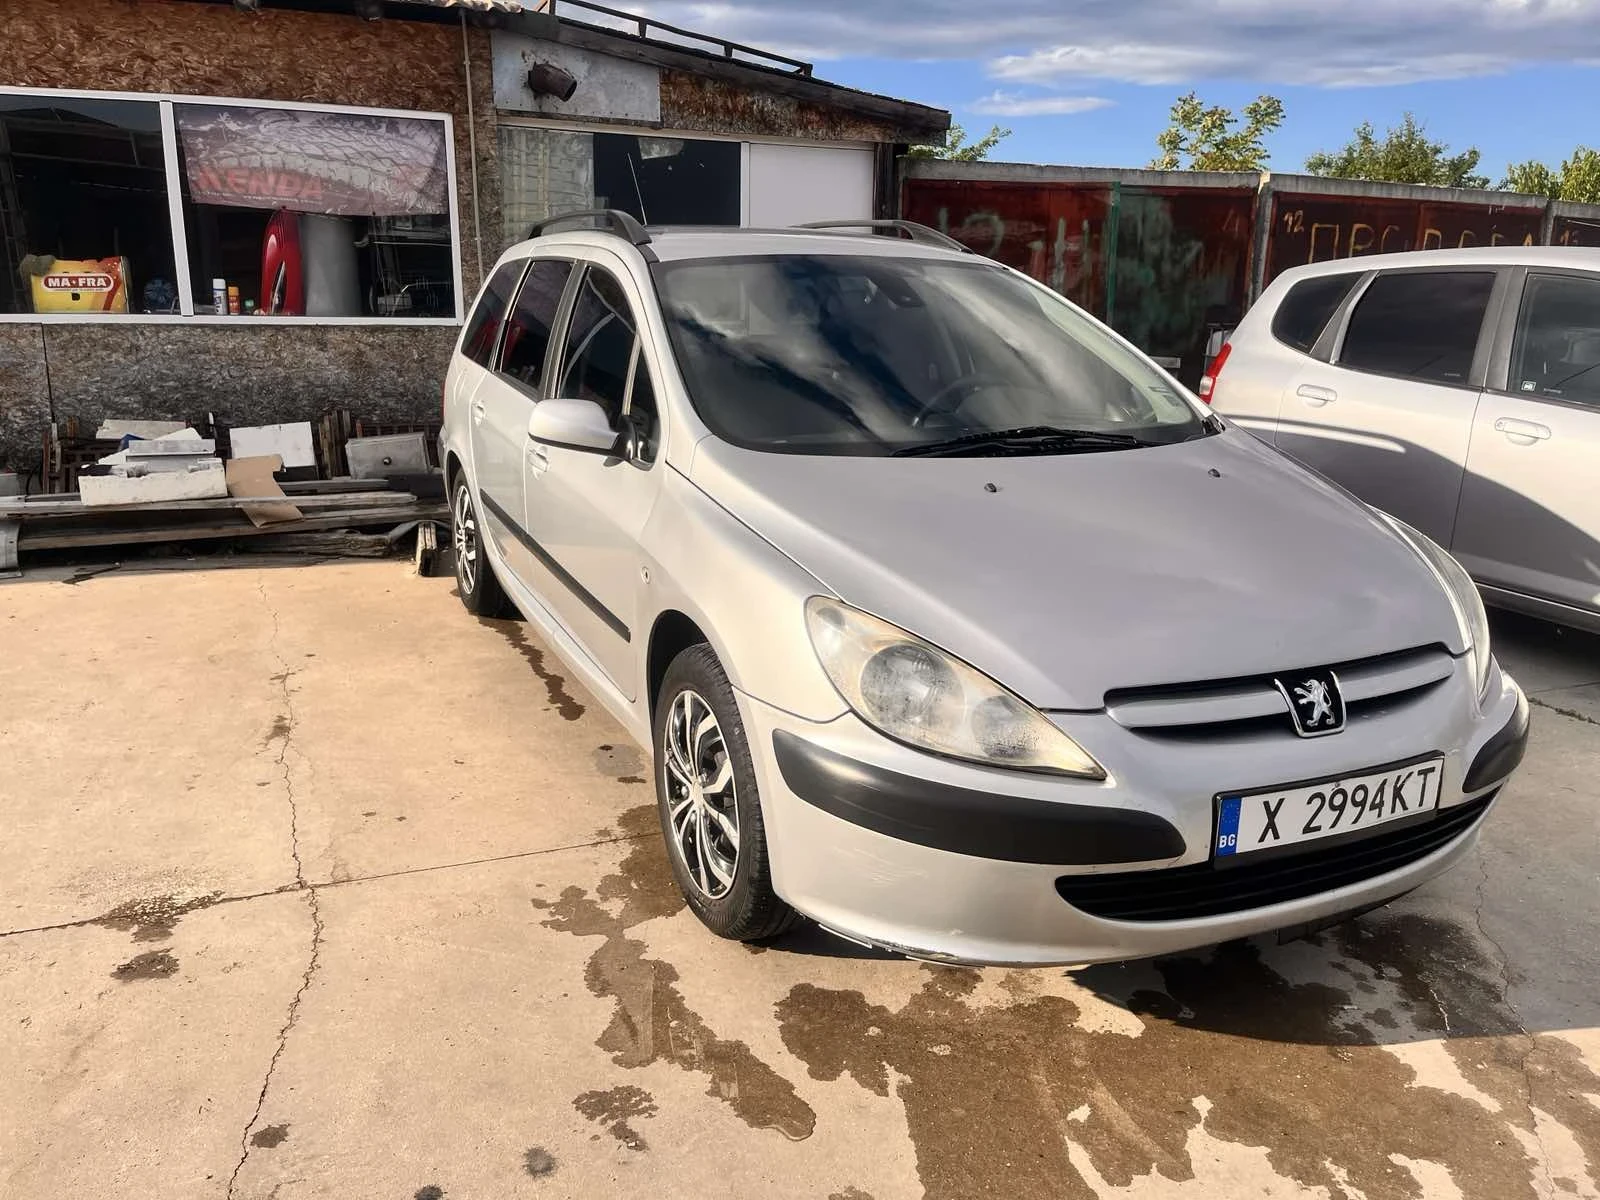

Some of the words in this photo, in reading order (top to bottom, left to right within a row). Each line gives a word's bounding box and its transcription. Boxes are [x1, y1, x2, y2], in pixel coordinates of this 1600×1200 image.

[1283, 209, 1305, 233] 12
[1257, 797, 1286, 843] X
[1302, 766, 1435, 834] 2994KT
[1218, 833, 1237, 849] BG
